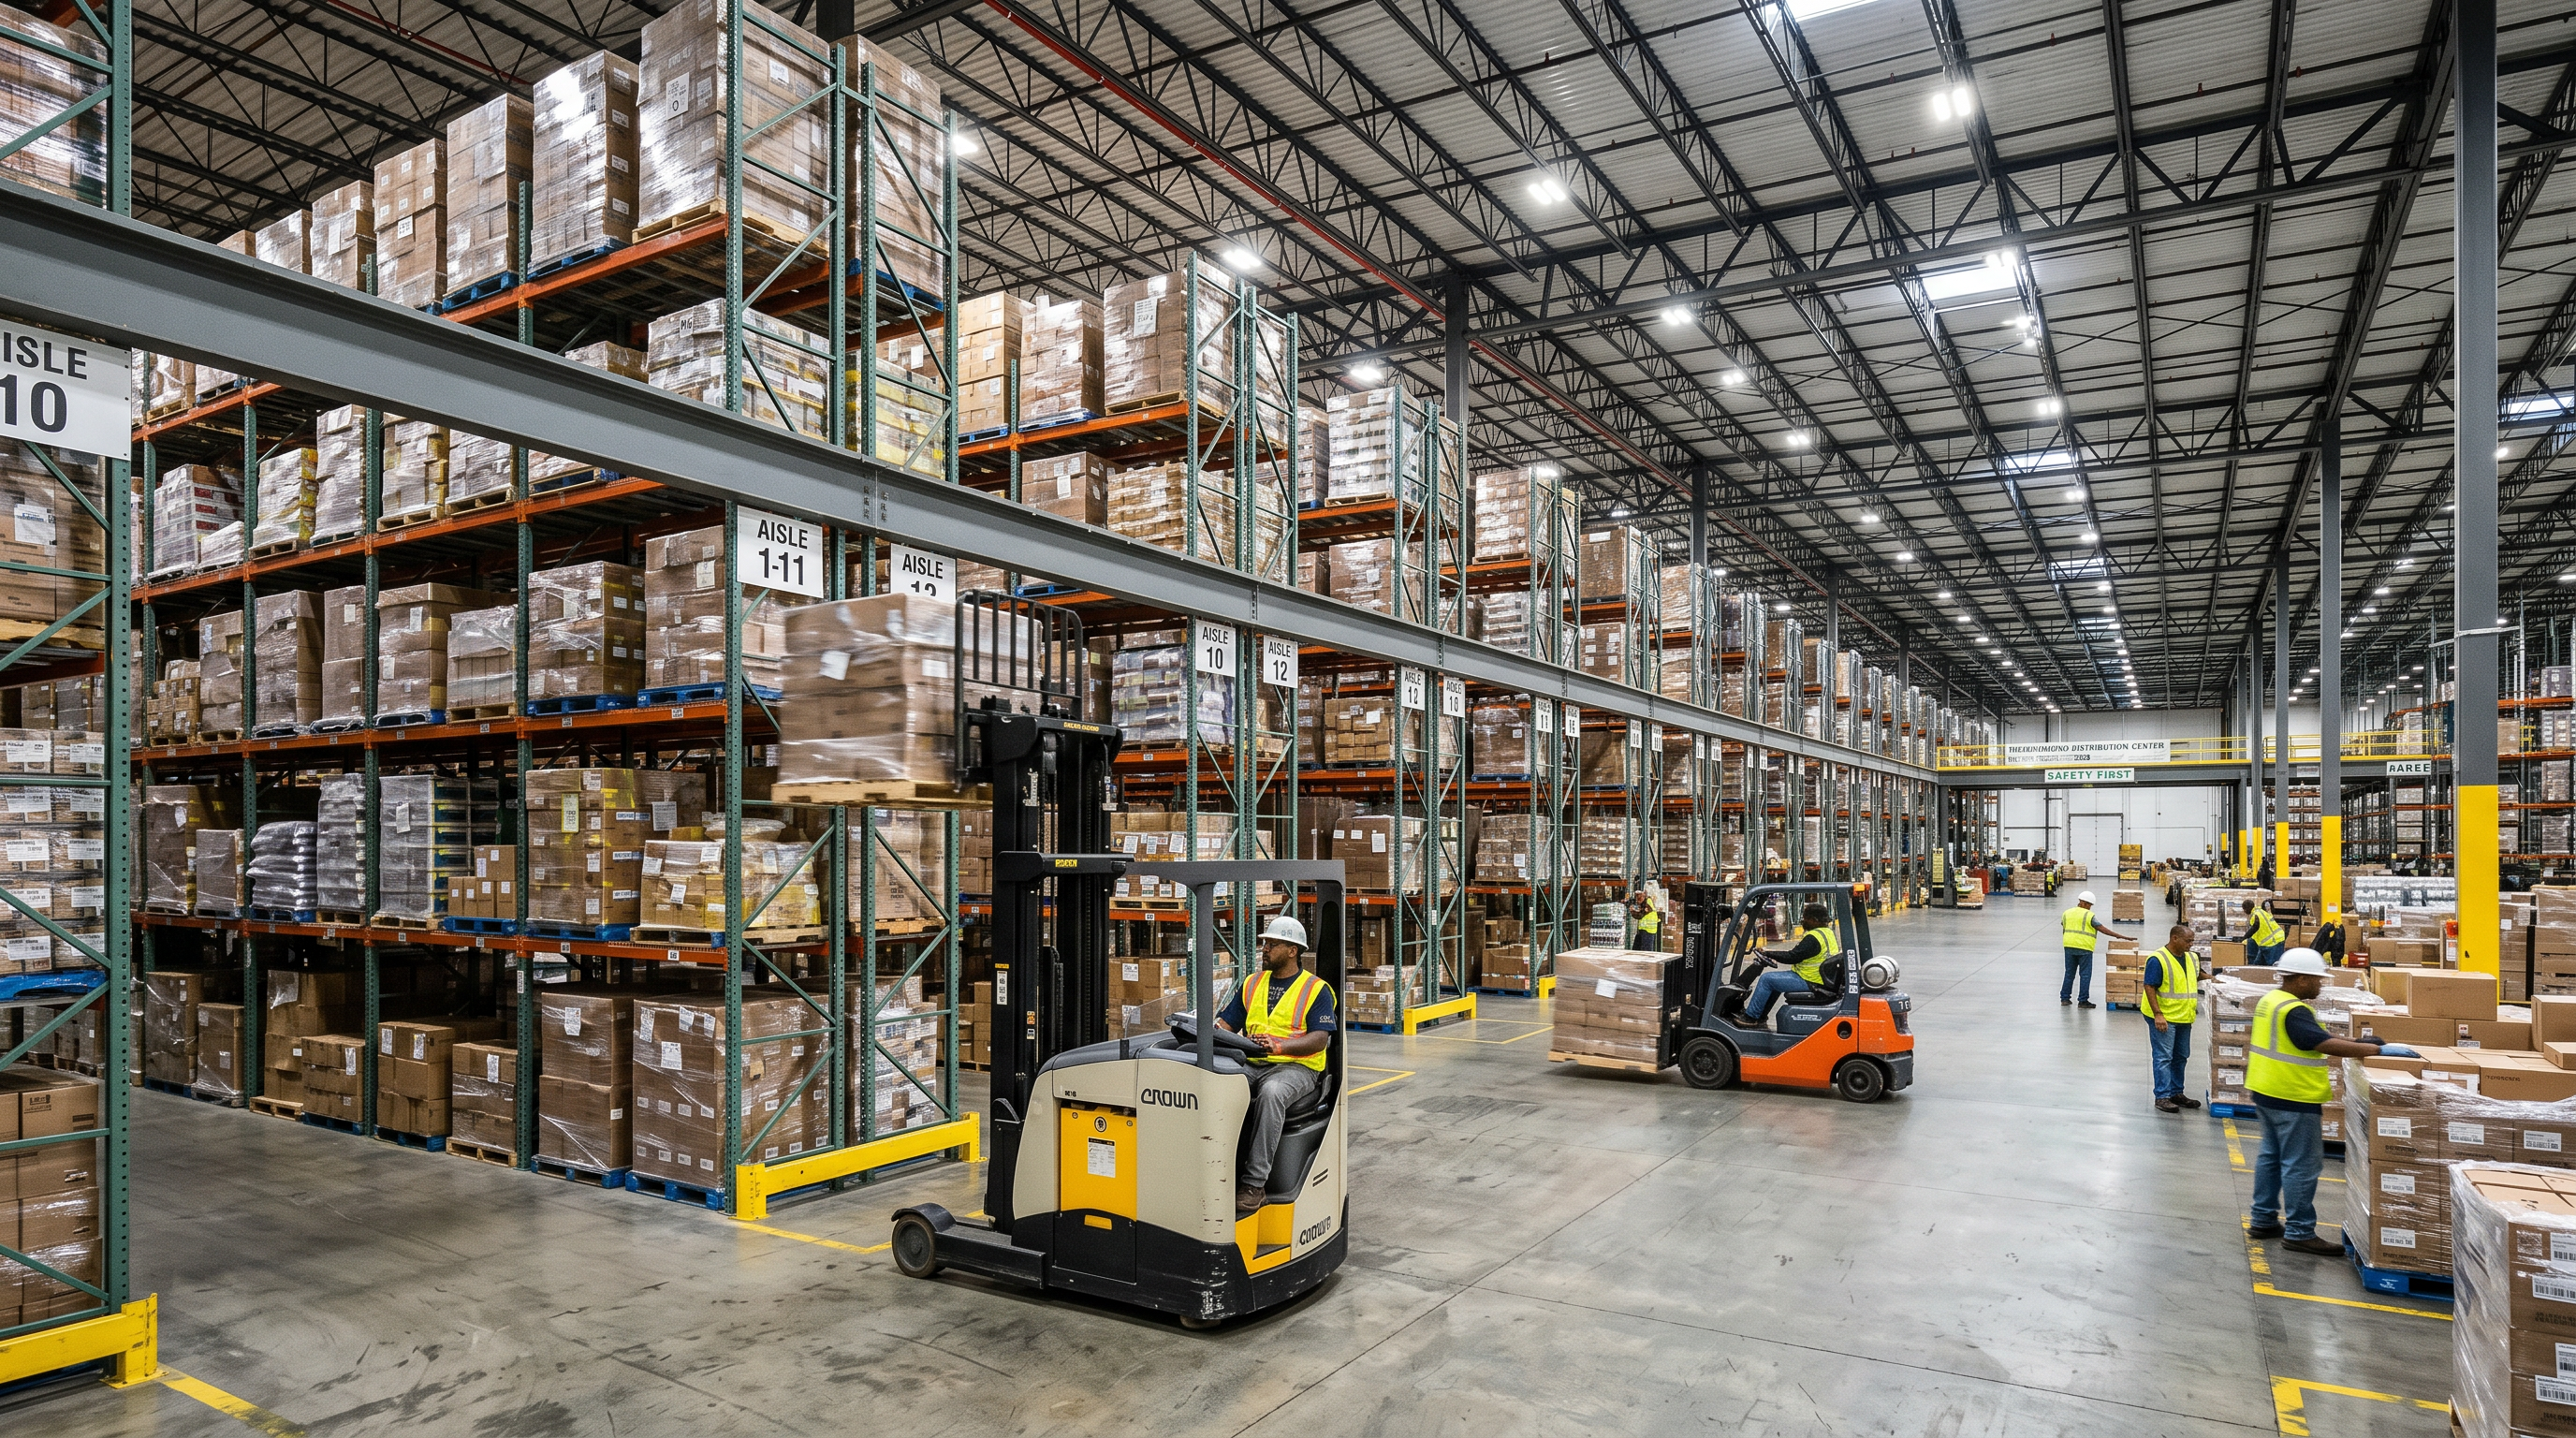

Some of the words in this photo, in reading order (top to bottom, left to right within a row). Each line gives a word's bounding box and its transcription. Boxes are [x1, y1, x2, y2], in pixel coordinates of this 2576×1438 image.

[0, 331, 87, 380] ISLE
[0, 374, 67, 433] 10
[757, 519, 808, 550] AISLE
[758, 547, 804, 586] 1-11
[901, 553, 944, 580] AISLE
[1202, 626, 1228, 645] AISLE
[1206, 646, 1223, 669] 10
[1267, 640, 1291, 658] AISLE
[1272, 659, 1288, 682] 12
[2071, 743, 2129, 752] DISTRIBUTION
[2131, 741, 2165, 750] CENTER
[2047, 770, 2093, 781] SAFETY
[2097, 770, 2132, 780] FIRST
